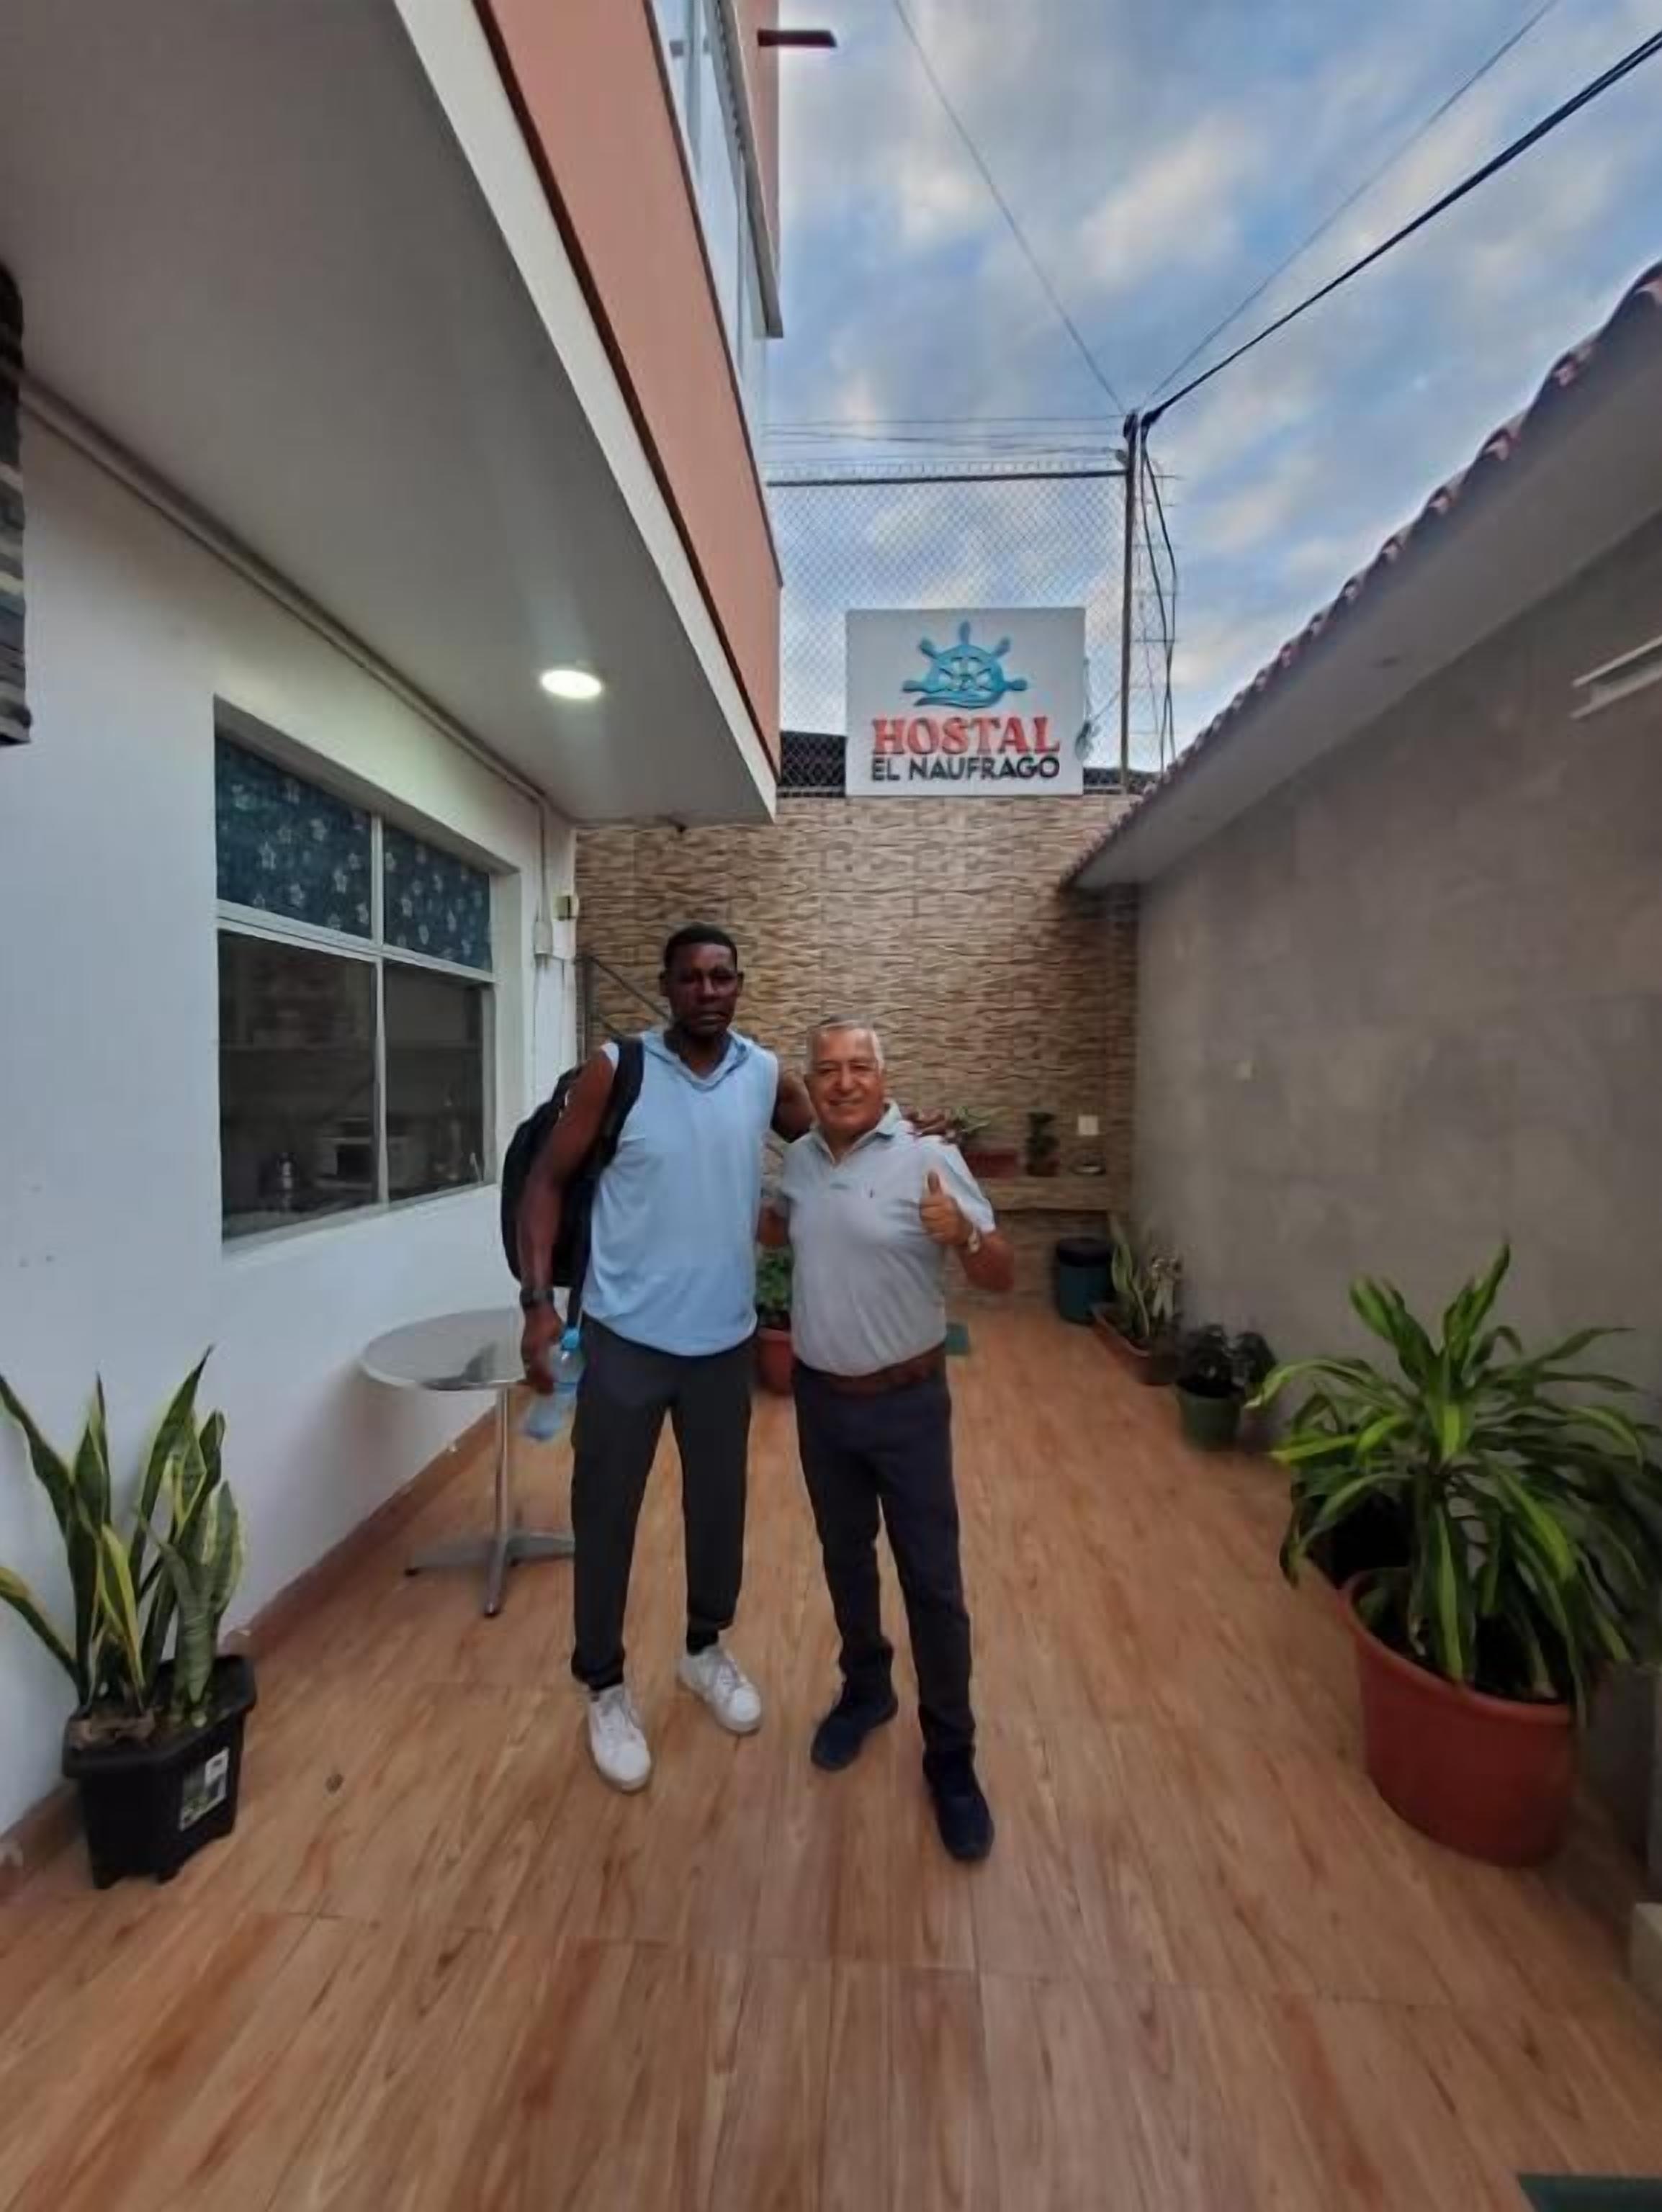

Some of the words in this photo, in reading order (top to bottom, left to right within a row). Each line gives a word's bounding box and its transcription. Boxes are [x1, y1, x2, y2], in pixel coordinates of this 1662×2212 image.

[872, 716, 1060, 755] HOSTAL
[872, 758, 900, 781] EL
[909, 757, 1060, 781] NAUFRAGO
